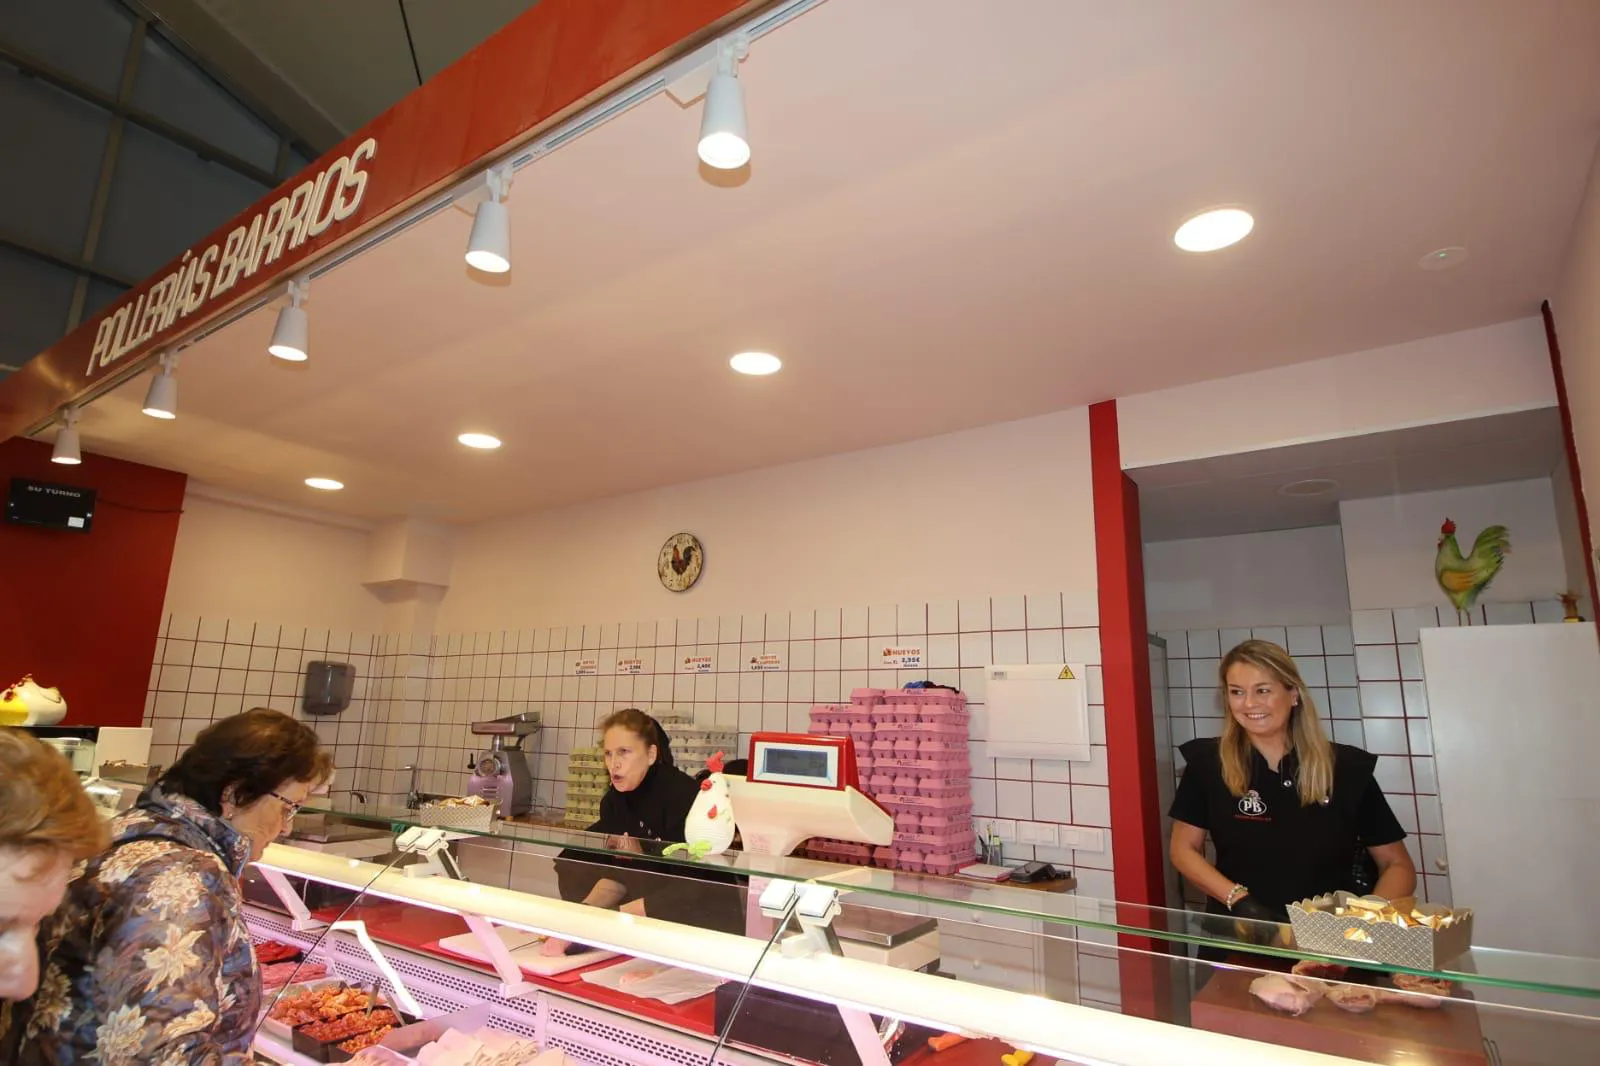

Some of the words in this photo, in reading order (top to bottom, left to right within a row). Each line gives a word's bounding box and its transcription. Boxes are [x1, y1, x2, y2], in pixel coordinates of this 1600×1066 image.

[210, 137, 377, 299] BARRIOS
[27, 485, 42, 493] SU
[45, 488, 81, 498] TURNO
[892, 648, 921, 656] HUEVOS
[1244, 798, 1262, 813] PB
